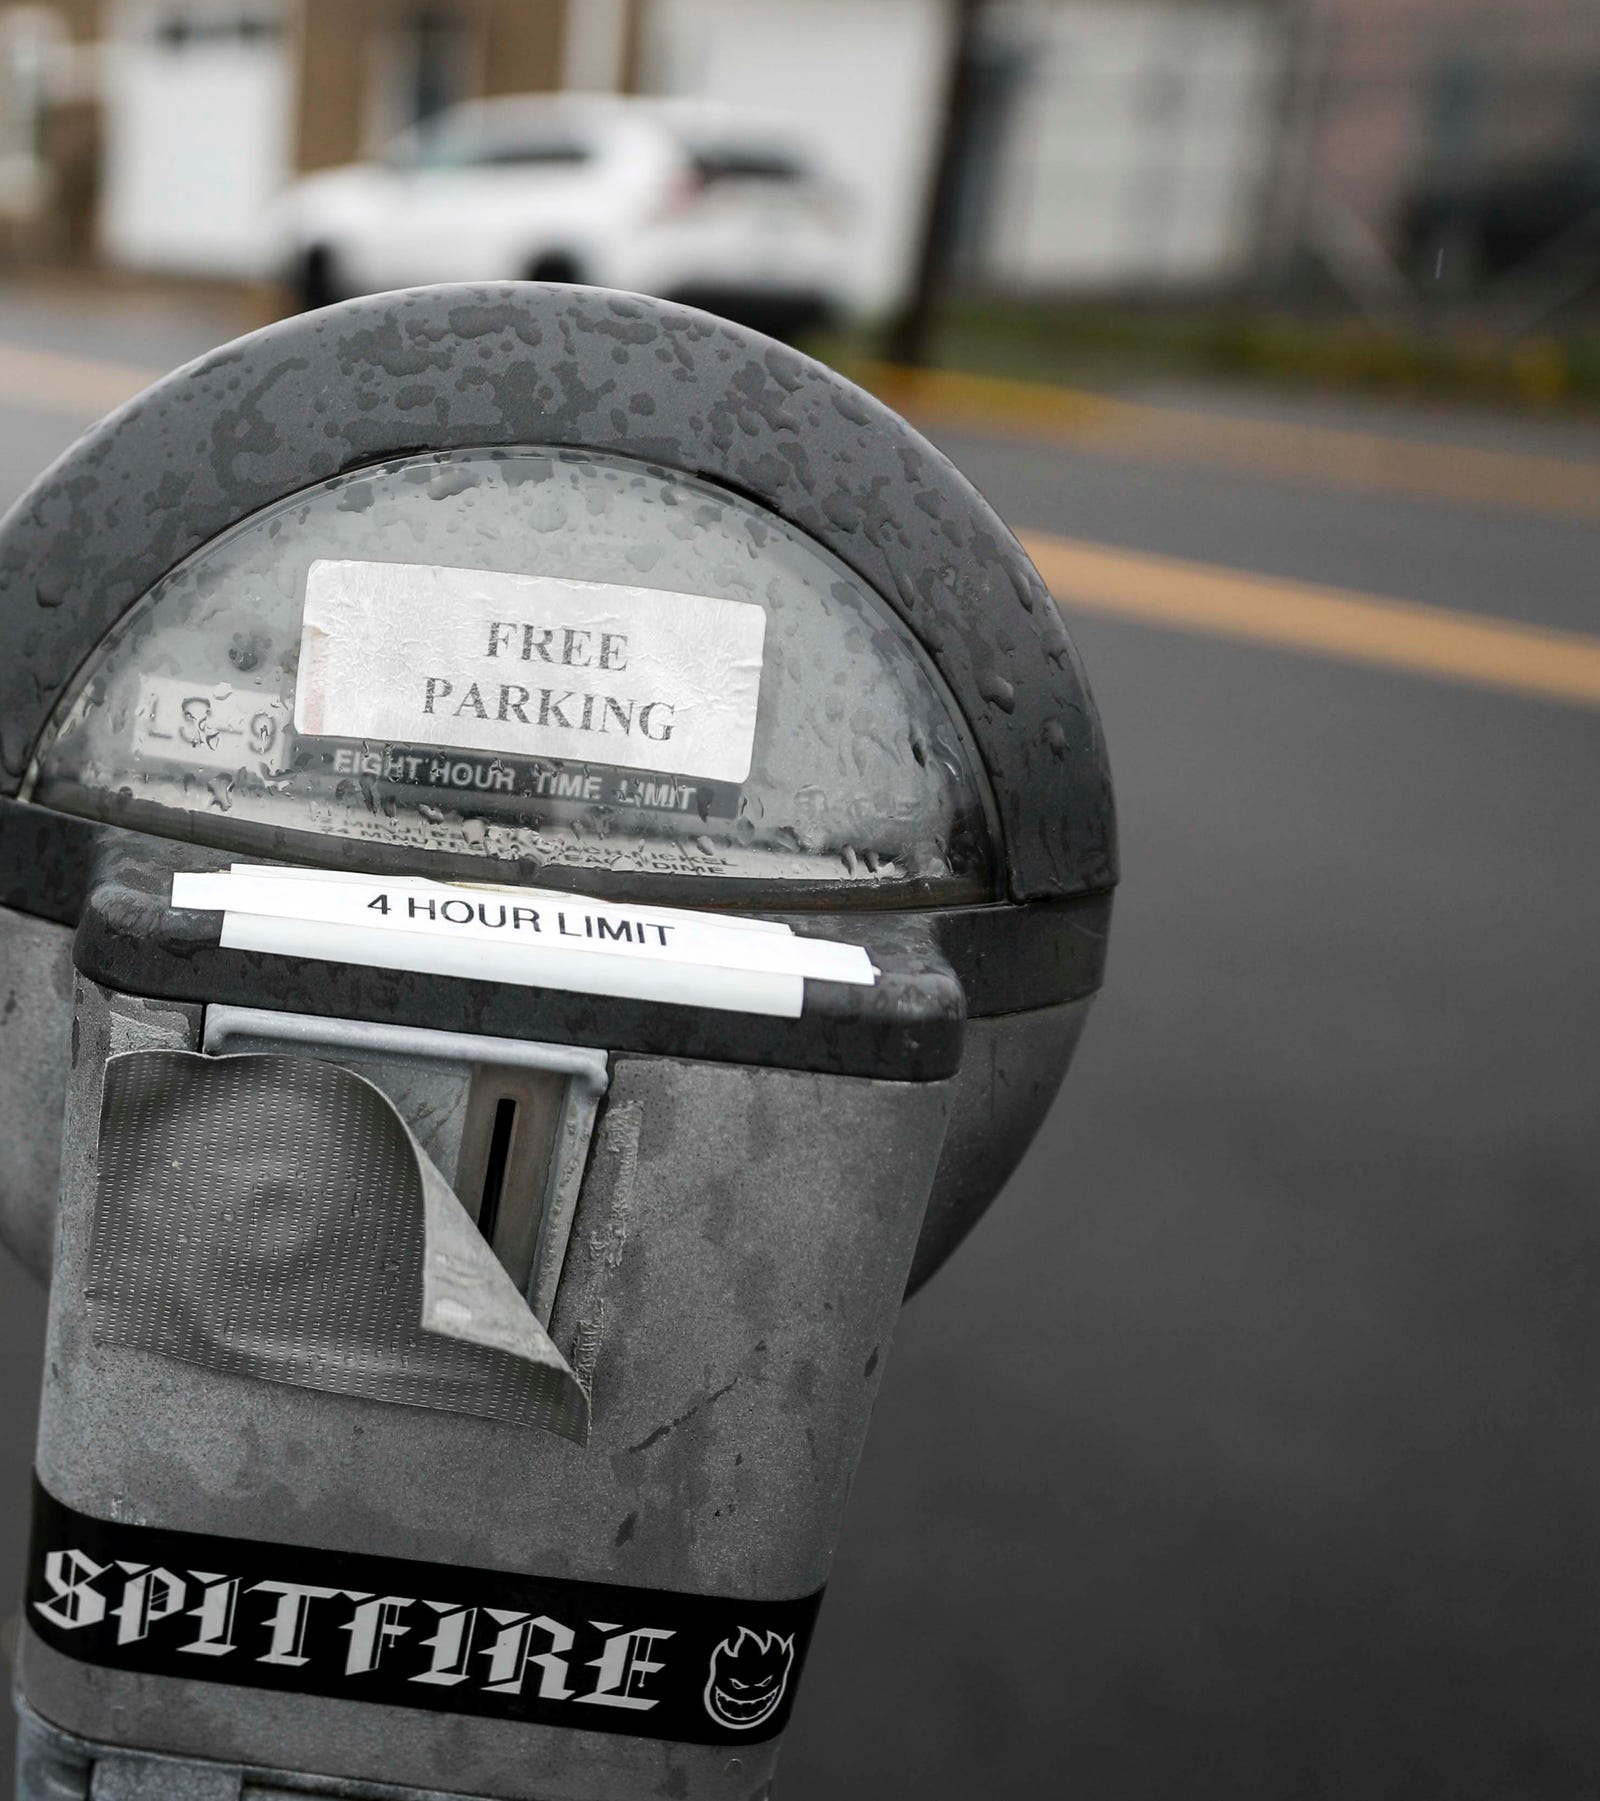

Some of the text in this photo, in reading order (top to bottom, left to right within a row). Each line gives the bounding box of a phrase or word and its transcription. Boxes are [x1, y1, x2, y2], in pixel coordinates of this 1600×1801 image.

[486, 621, 629, 672] FREE
[423, 676, 675, 742] PARKING
[333, 749, 698, 810] EIGHT HOUR TIME LIMIT
[652, 861, 727, 877] DIME
[367, 894, 676, 946] 4 HOUR LIMIT
[34, 1548, 677, 1711] SPITFIRE
